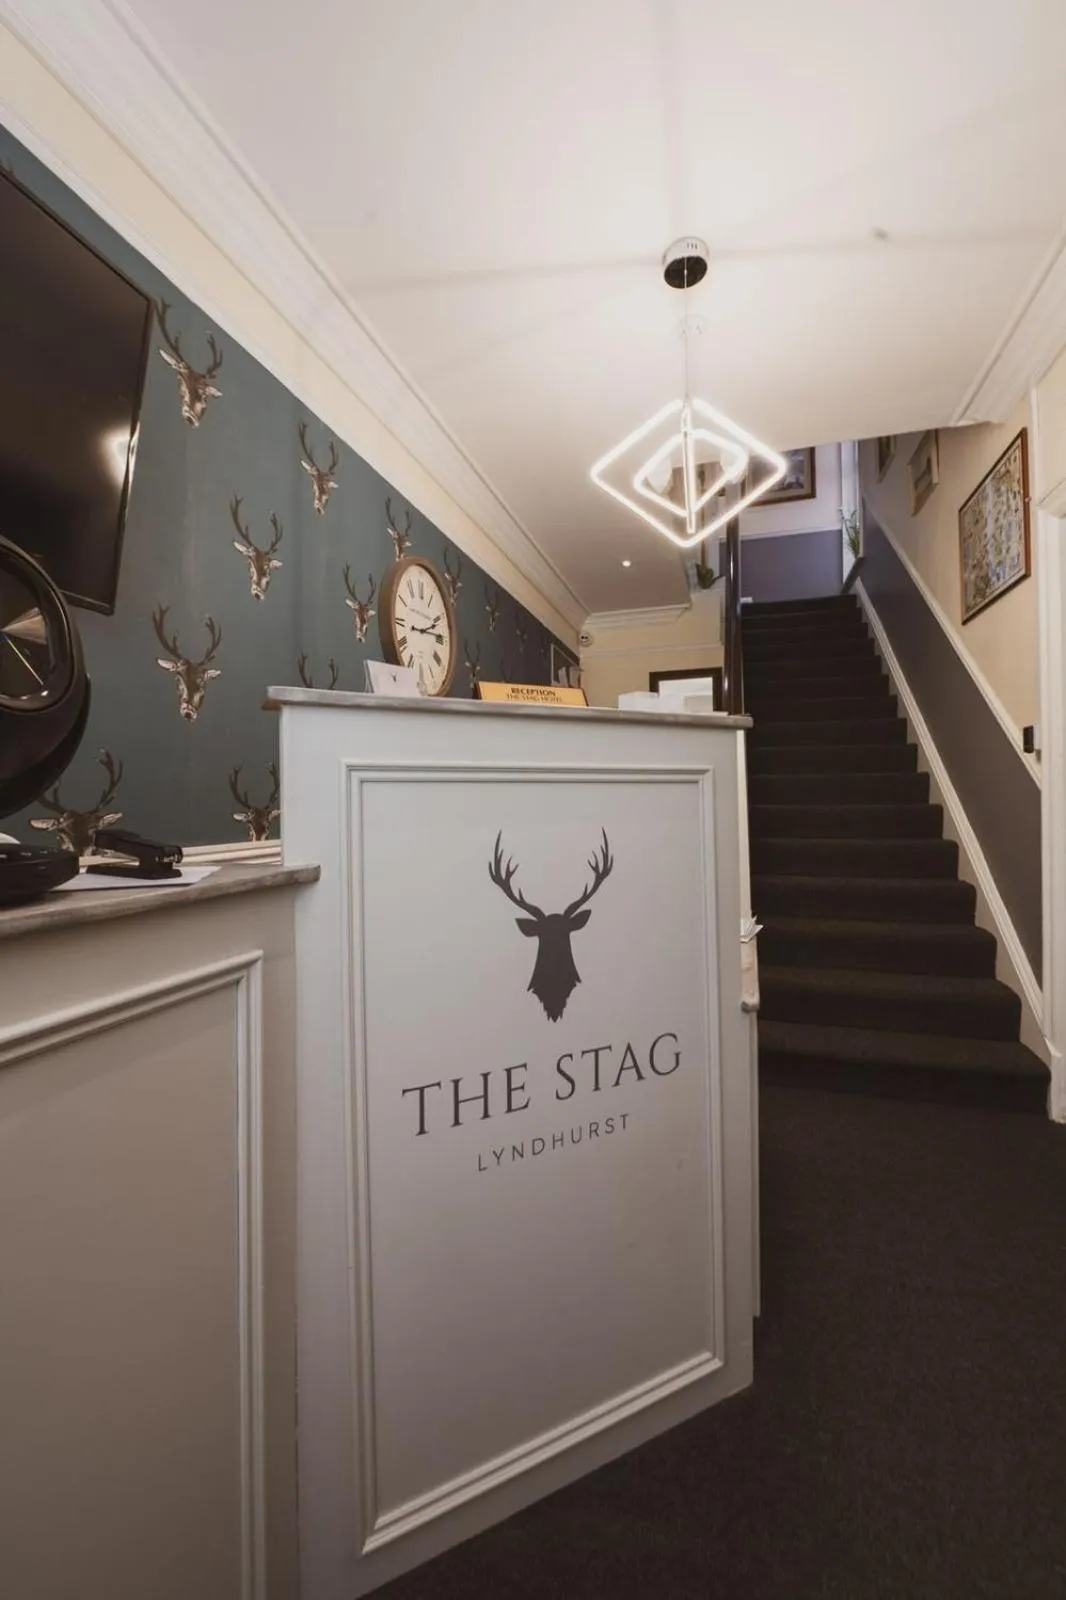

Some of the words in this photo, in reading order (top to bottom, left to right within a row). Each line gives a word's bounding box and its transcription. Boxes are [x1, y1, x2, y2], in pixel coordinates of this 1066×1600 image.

[510, 687, 556, 697] RECEPTION
[402, 1063, 531, 1136] THE
[555, 1032, 682, 1101] STAG
[477, 1114, 630, 1172] LYNDHURST
